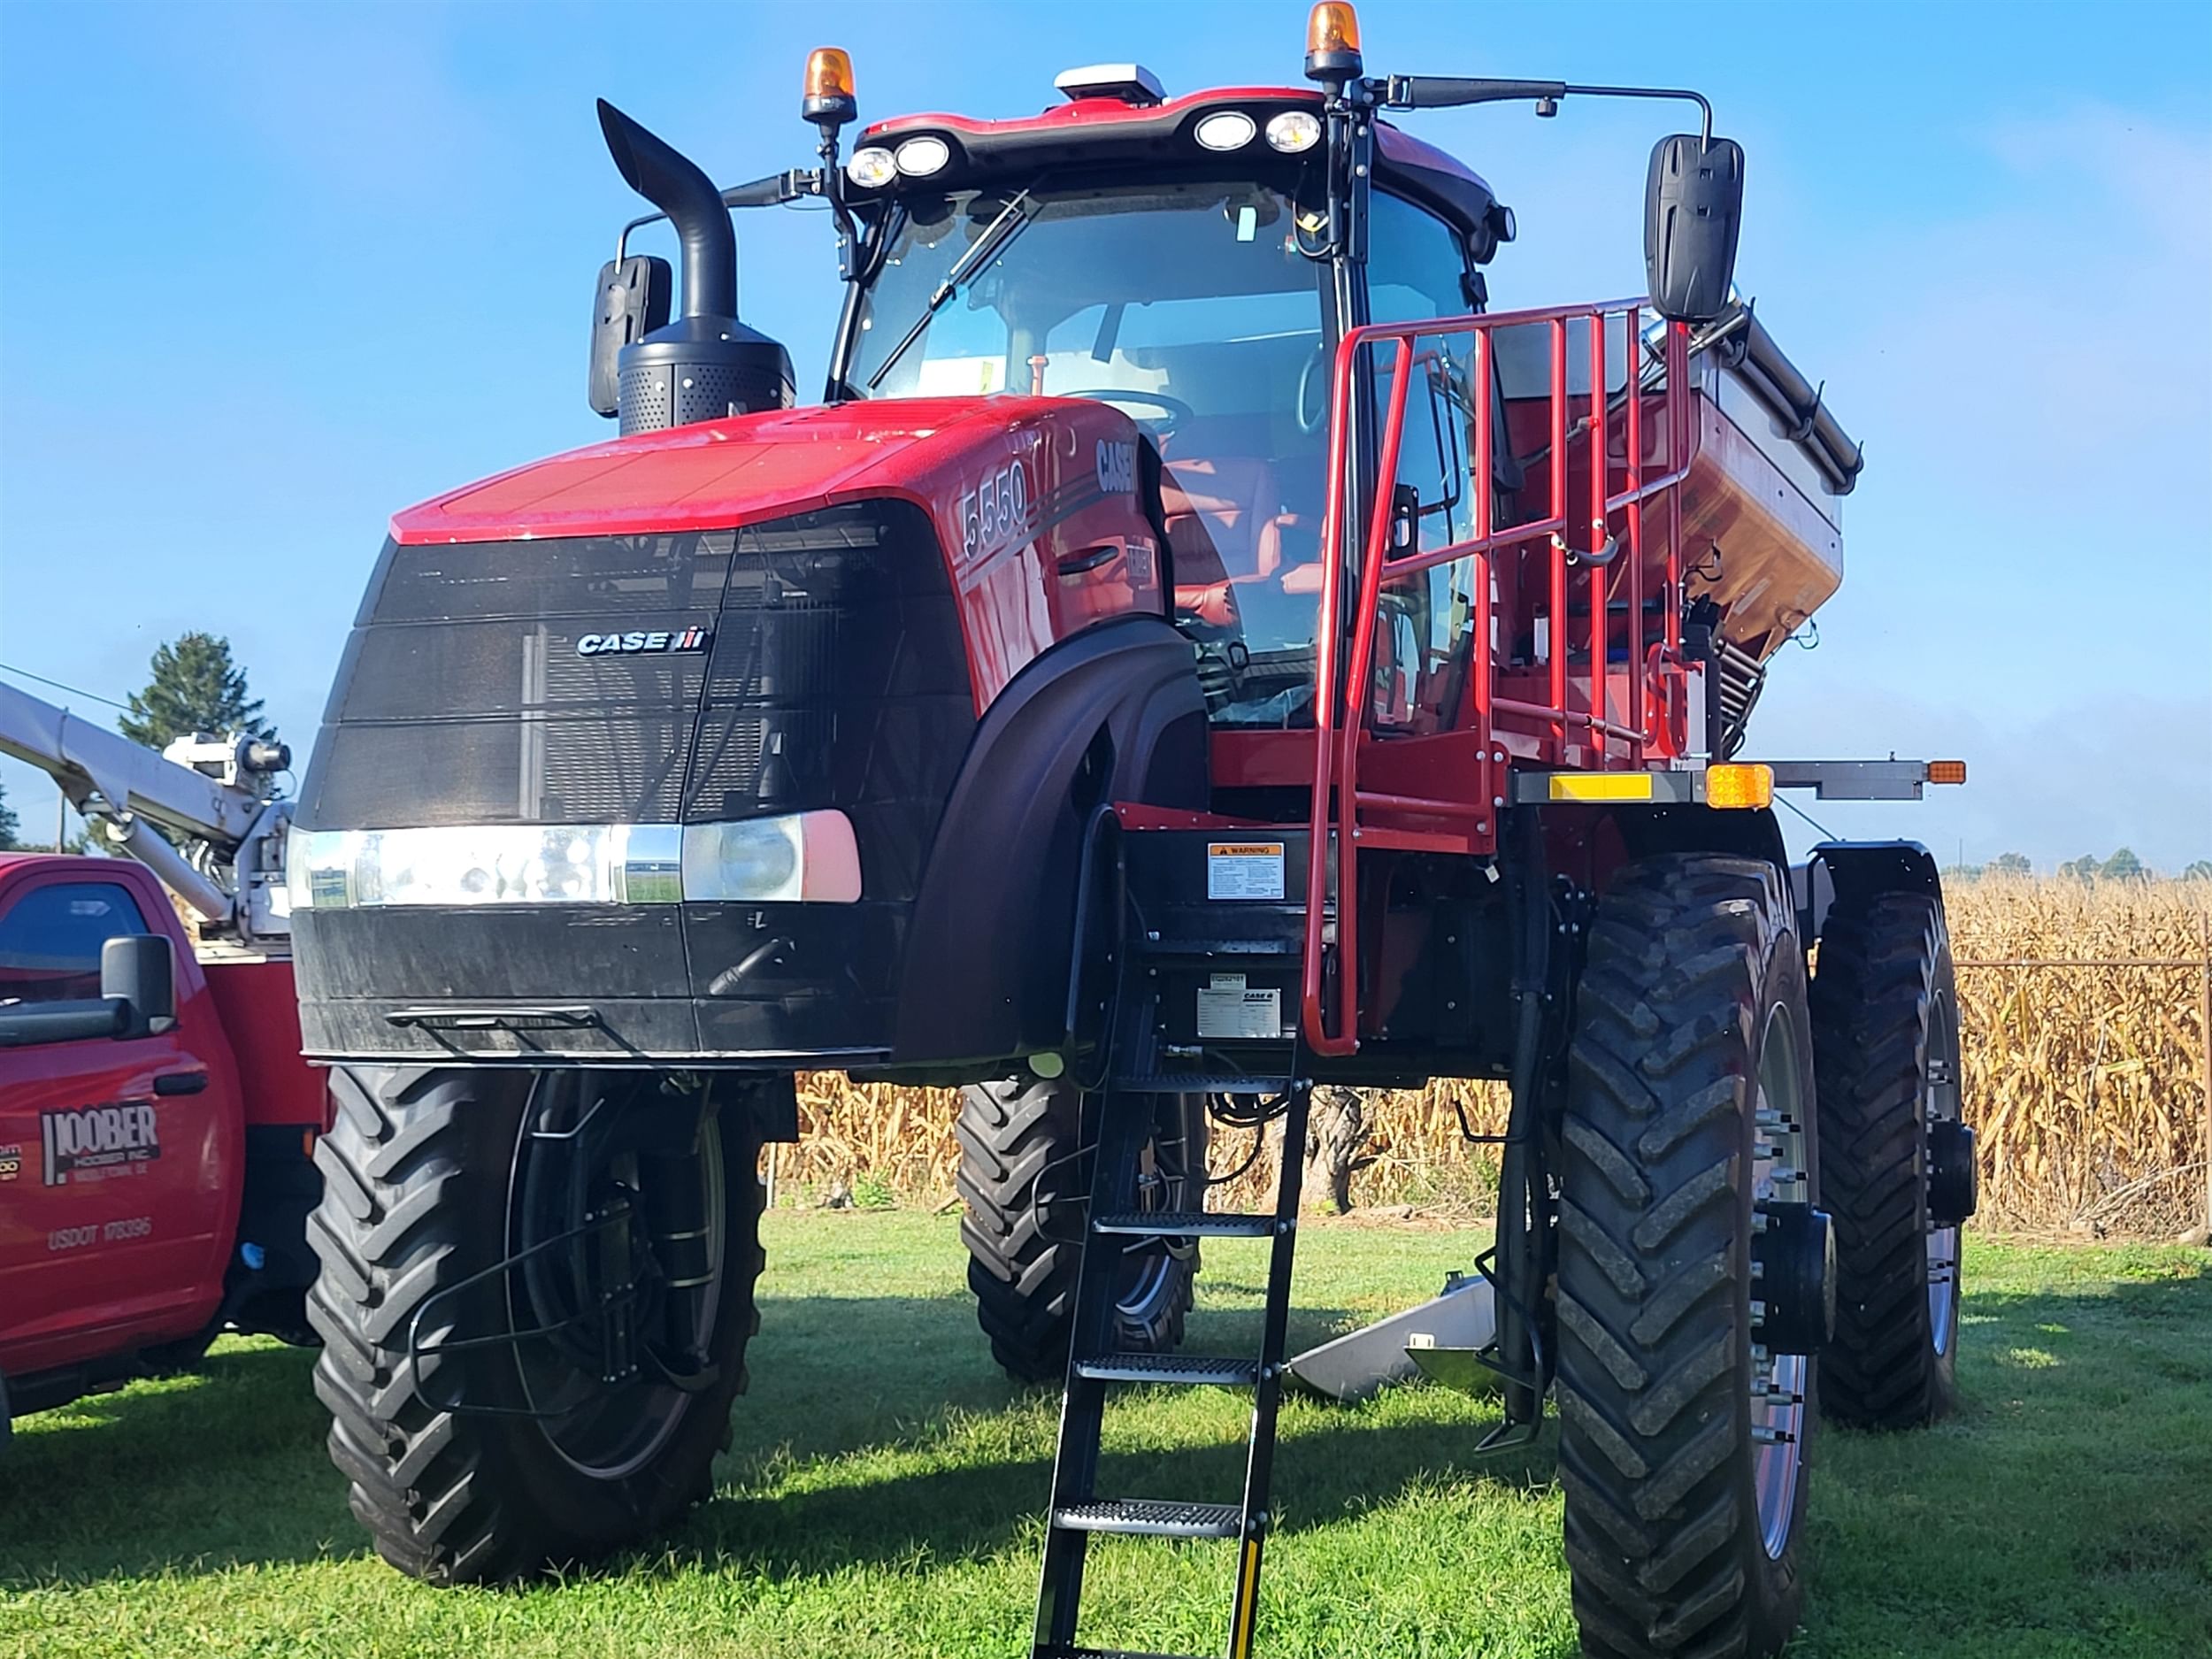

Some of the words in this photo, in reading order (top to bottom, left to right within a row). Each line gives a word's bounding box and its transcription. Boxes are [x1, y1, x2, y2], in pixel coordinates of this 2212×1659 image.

[963, 459, 1027, 561] 5550
[577, 632, 669, 654] CASE
[42, 1105, 157, 1186] HOOBER
[48, 1225, 99, 1250] USDOT
